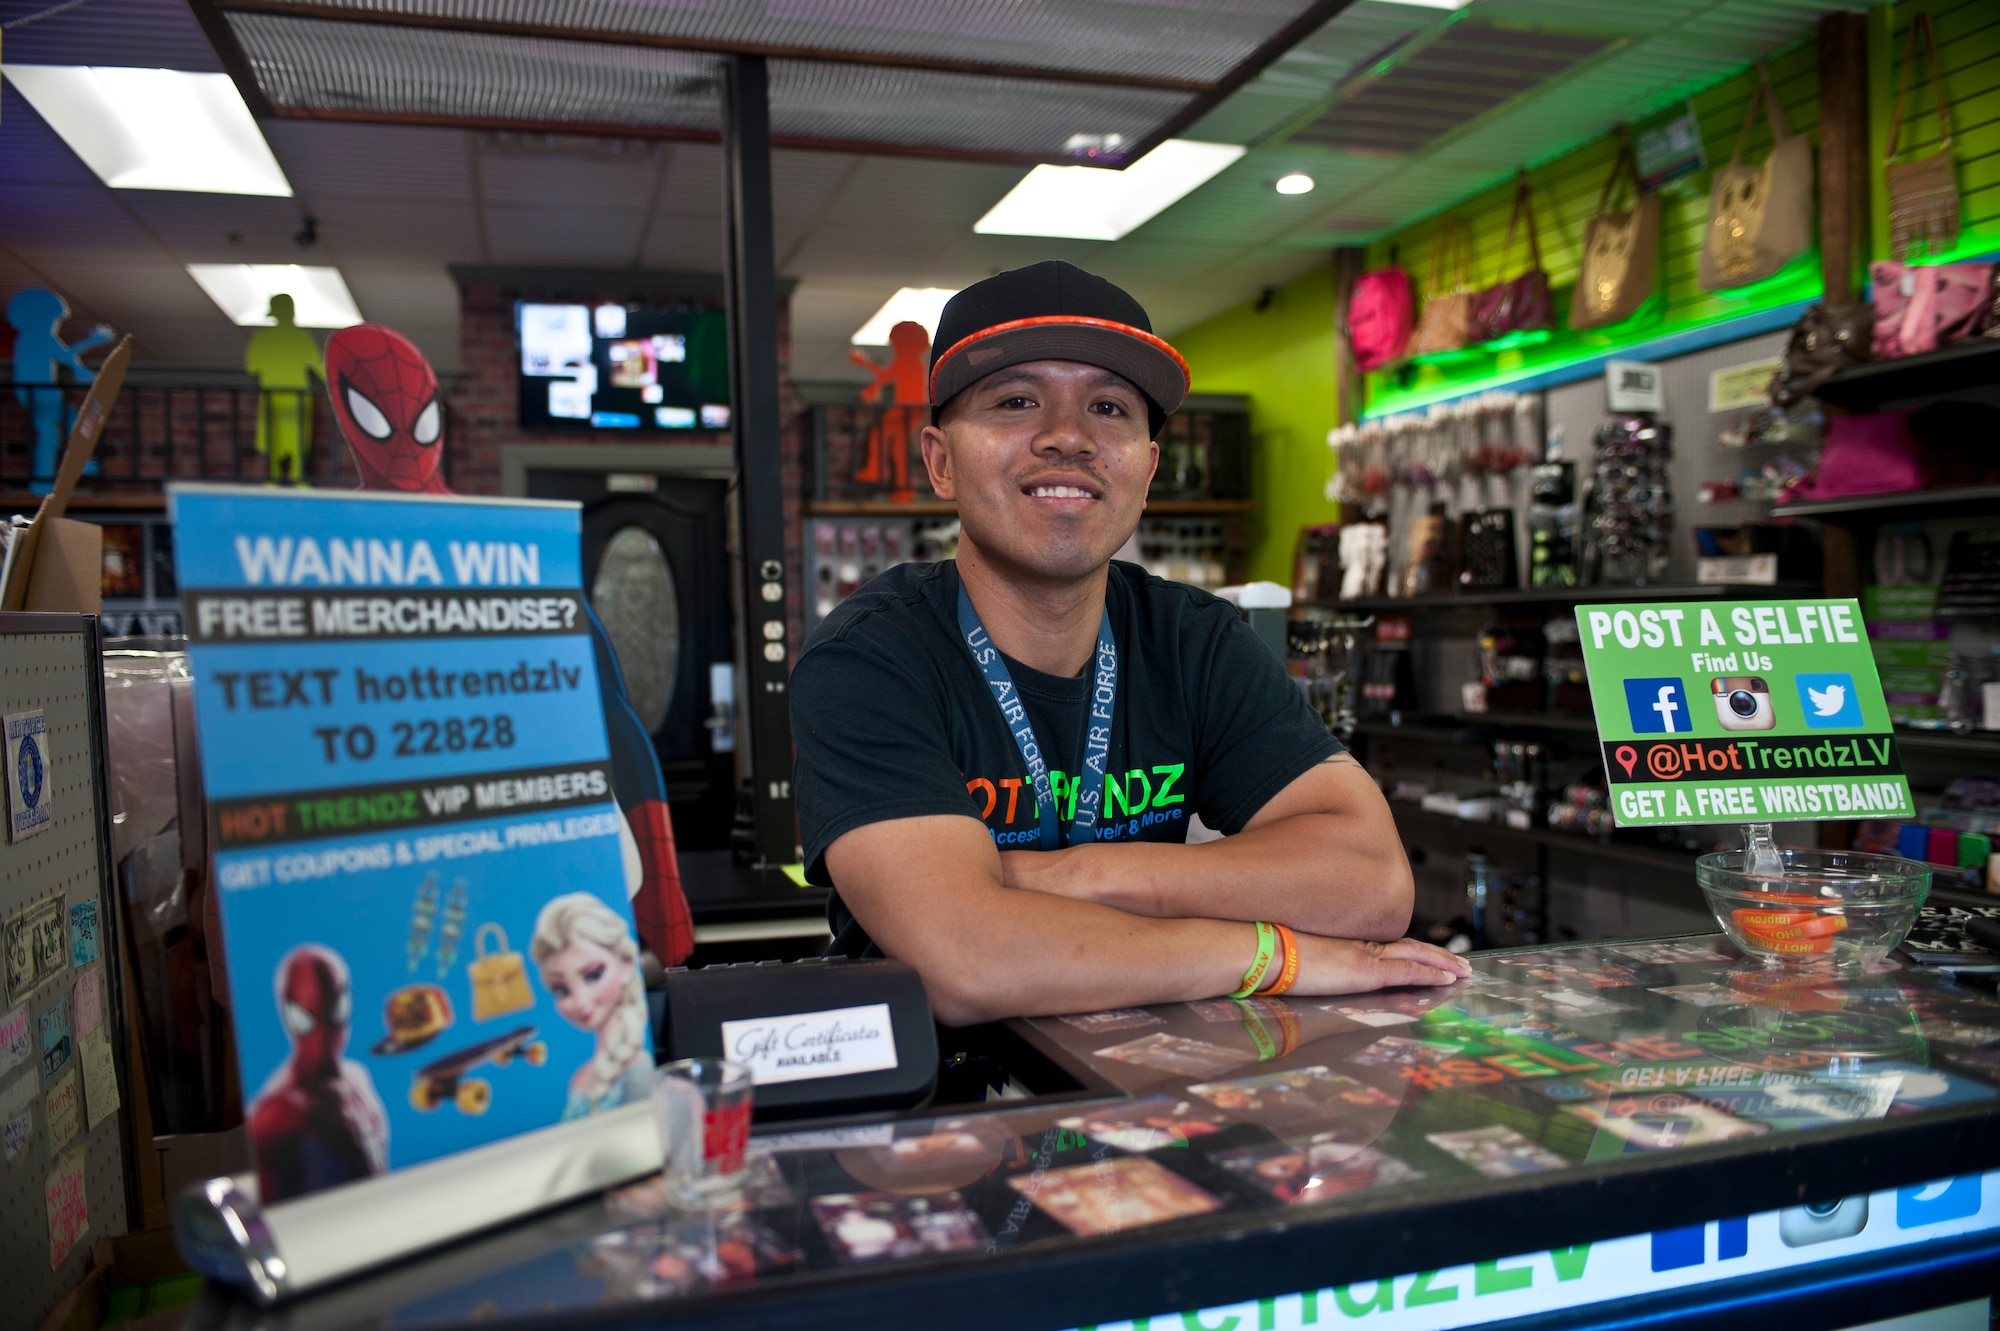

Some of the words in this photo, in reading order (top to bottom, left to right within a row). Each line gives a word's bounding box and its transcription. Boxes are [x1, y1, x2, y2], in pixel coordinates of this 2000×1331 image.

[235, 535, 444, 585] WANNA
[449, 541, 540, 585] WIN
[199, 598, 307, 638] FREE
[311, 598, 578, 635] MERCHANDISE?
[1588, 608, 1684, 649] POST
[1700, 608, 1726, 646] A
[1731, 605, 1859, 645] SELFIE
[1092, 640, 1116, 719] FORCE
[1691, 652, 1739, 673] Find
[1742, 651, 1773, 672] Us
[213, 669, 338, 711] TEXT
[356, 659, 581, 702] hottrendzlv
[22, 716, 46, 736] FORCE
[967, 626, 996, 673] U.S.
[990, 680, 1024, 725] AIR
[1015, 727, 1054, 808] FORCE
[314, 725, 376, 763] TO
[392, 715, 516, 758] 22828
[1085, 726, 1110, 775] AIR
[1647, 738, 1891, 780] @HotTrendzLV
[14, 802, 51, 832] VETERAN
[218, 803, 290, 840] HOT
[296, 789, 420, 832] TRENDZ
[423, 784, 471, 817] VIP
[475, 771, 608, 809] MEMBERS
[1076, 783, 1102, 827] U.S.
[1129, 819, 1140, 835] &
[1141, 808, 1183, 827] More
[1620, 789, 1666, 819] GET
[1675, 789, 1693, 817] A
[1694, 786, 1758, 816] FREE
[1759, 782, 1907, 814] WRISTBAND!
[220, 861, 272, 892] GET
[274, 843, 392, 880] COUPONS
[394, 840, 414, 865] &
[415, 829, 503, 859] SPECIAL
[505, 813, 620, 846] PRIVILEGES
[1284, 948, 1297, 983] Selfie
[735, 1027, 778, 1064] Gift
[784, 1021, 881, 1051] Certificates
[776, 1051, 842, 1067] AVAILABLE
